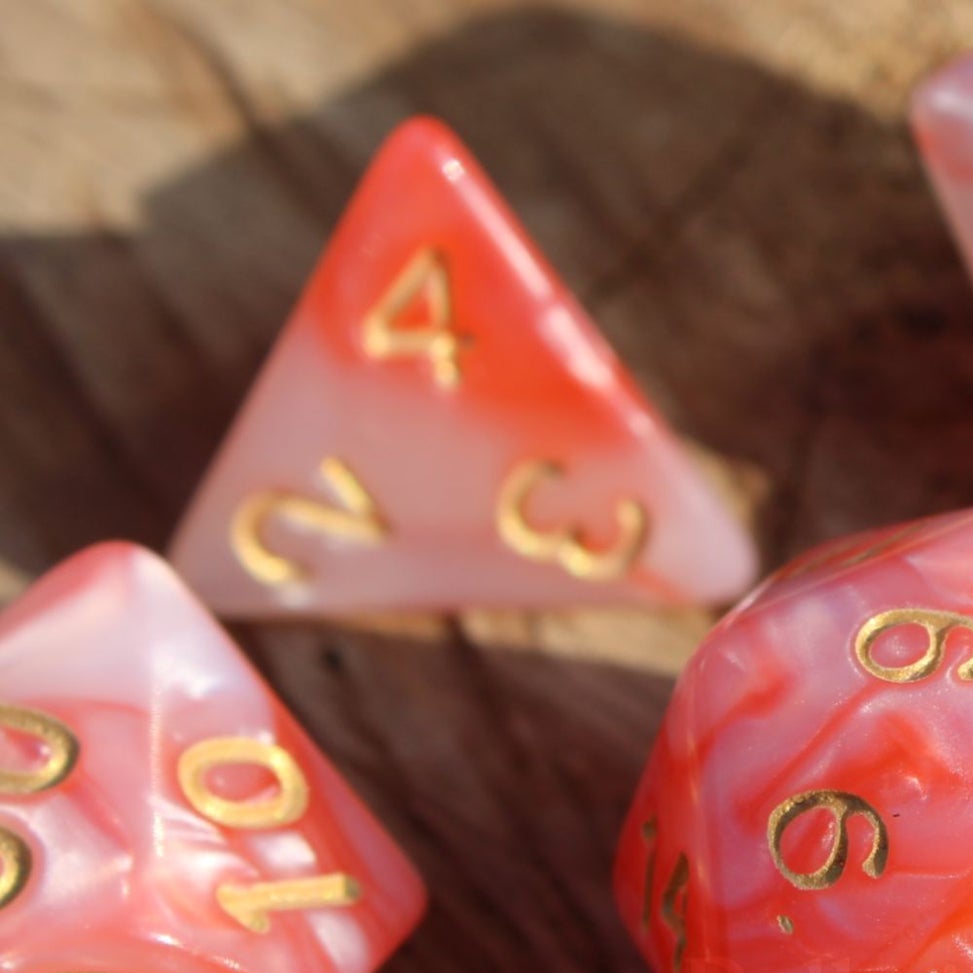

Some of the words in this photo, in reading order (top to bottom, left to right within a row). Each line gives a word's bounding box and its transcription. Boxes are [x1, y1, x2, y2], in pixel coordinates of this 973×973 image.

[361, 245, 477, 397] 4
[228, 455, 390, 592] 2
[495, 460, 652, 584] 3
